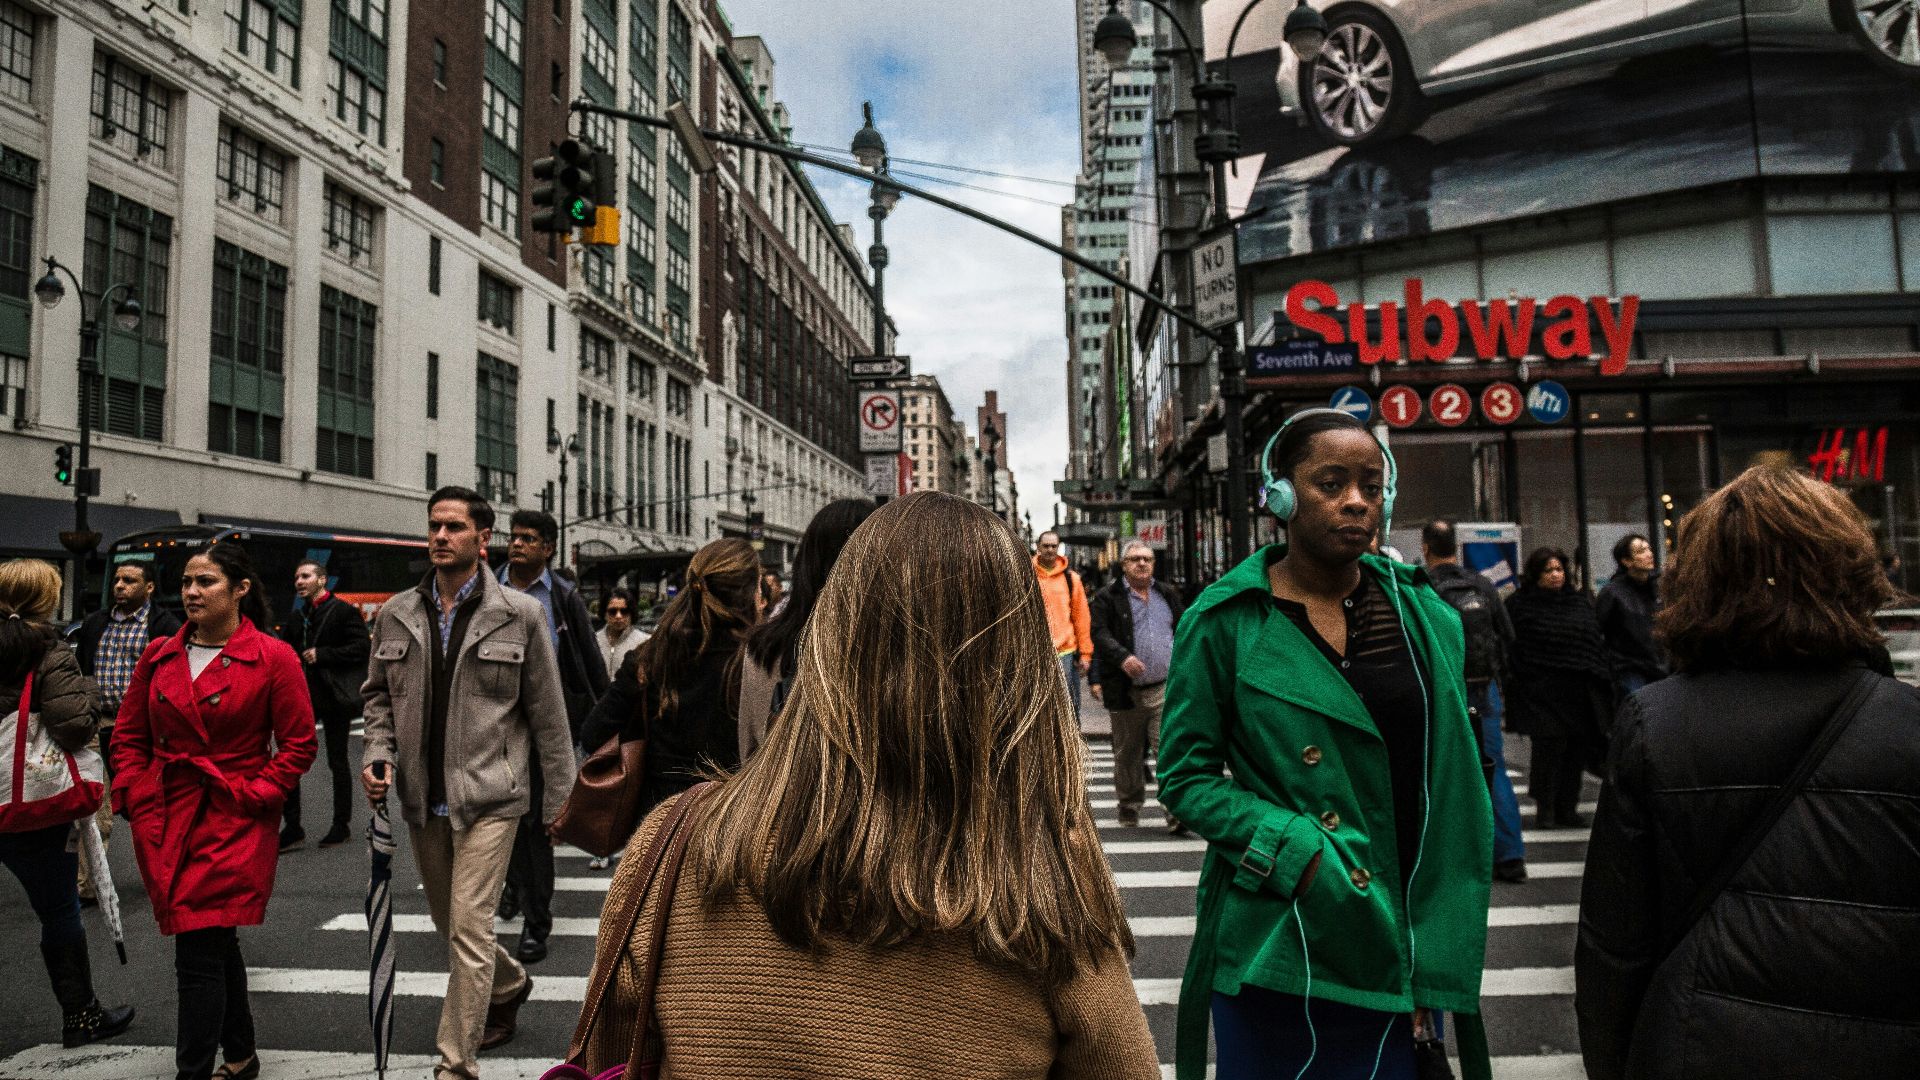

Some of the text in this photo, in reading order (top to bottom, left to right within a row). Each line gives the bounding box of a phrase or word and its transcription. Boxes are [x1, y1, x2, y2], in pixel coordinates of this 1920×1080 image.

[1202, 245, 1224, 274] NO
[1196, 273, 1235, 301] TURNS
[1285, 278, 1640, 375] Subway
[1256, 350, 1353, 369] Seventh Ave
[1390, 391, 1407, 421] 1
[1439, 391, 1462, 420] 2
[1490, 387, 1513, 417] 3
